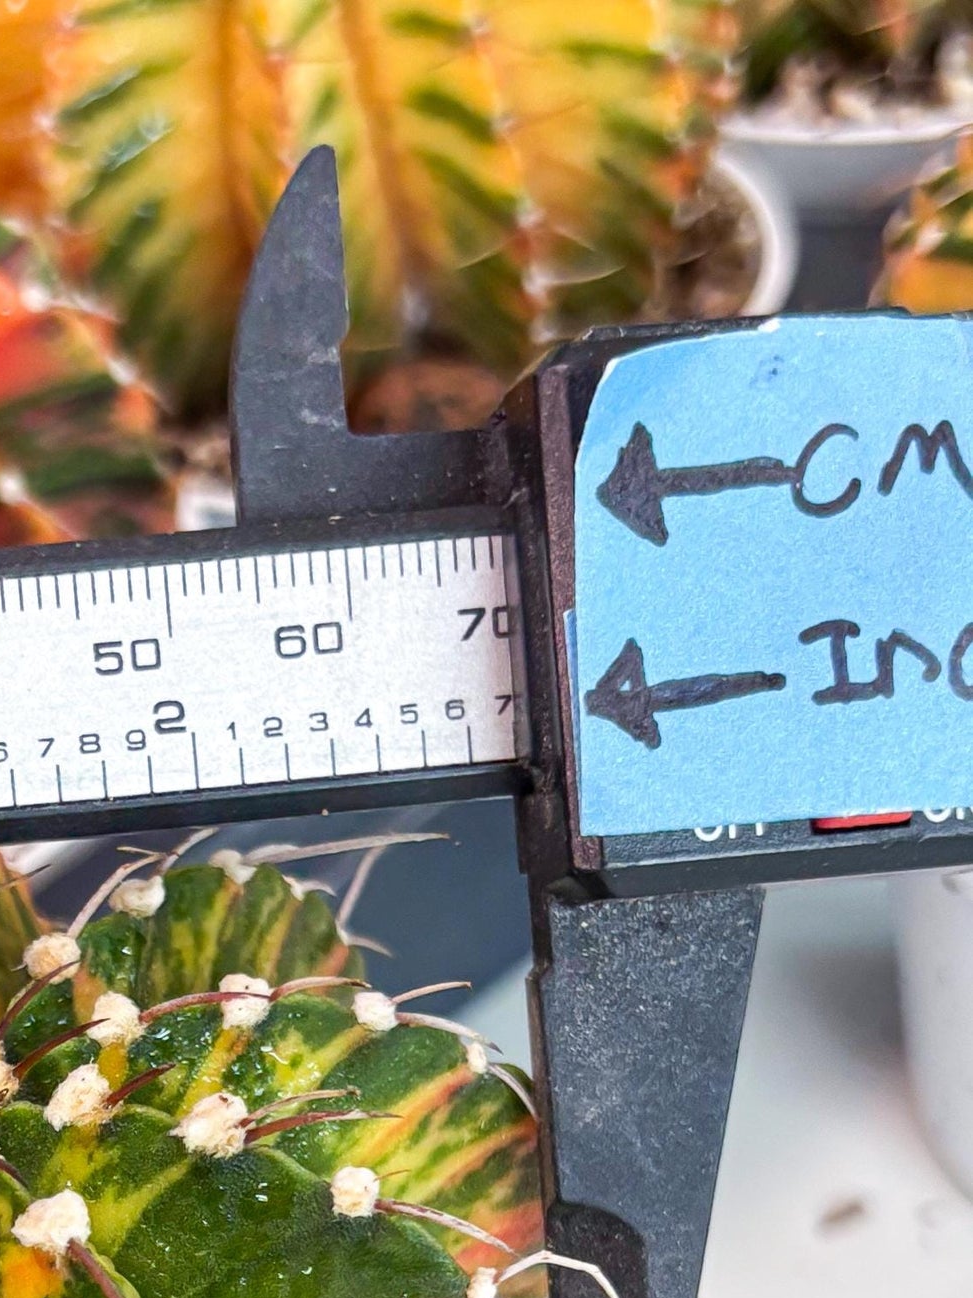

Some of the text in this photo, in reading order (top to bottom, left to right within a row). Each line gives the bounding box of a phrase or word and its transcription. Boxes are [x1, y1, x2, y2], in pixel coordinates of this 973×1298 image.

[93, 638, 161, 675] 50
[274, 622, 342, 658] 60
[38, 737, 55, 757] 7
[79, 733, 101, 753] 8
[125, 729, 147, 751] 9
[153, 700, 186, 734] 2
[226, 722, 237, 740] 1
[263, 717, 283, 737] 2
[309, 712, 329, 731] 3
[354, 708, 372, 727] 4
[400, 704, 419, 724] 5
[445, 699, 465, 720] 6
[495, 694, 513, 716] 7
